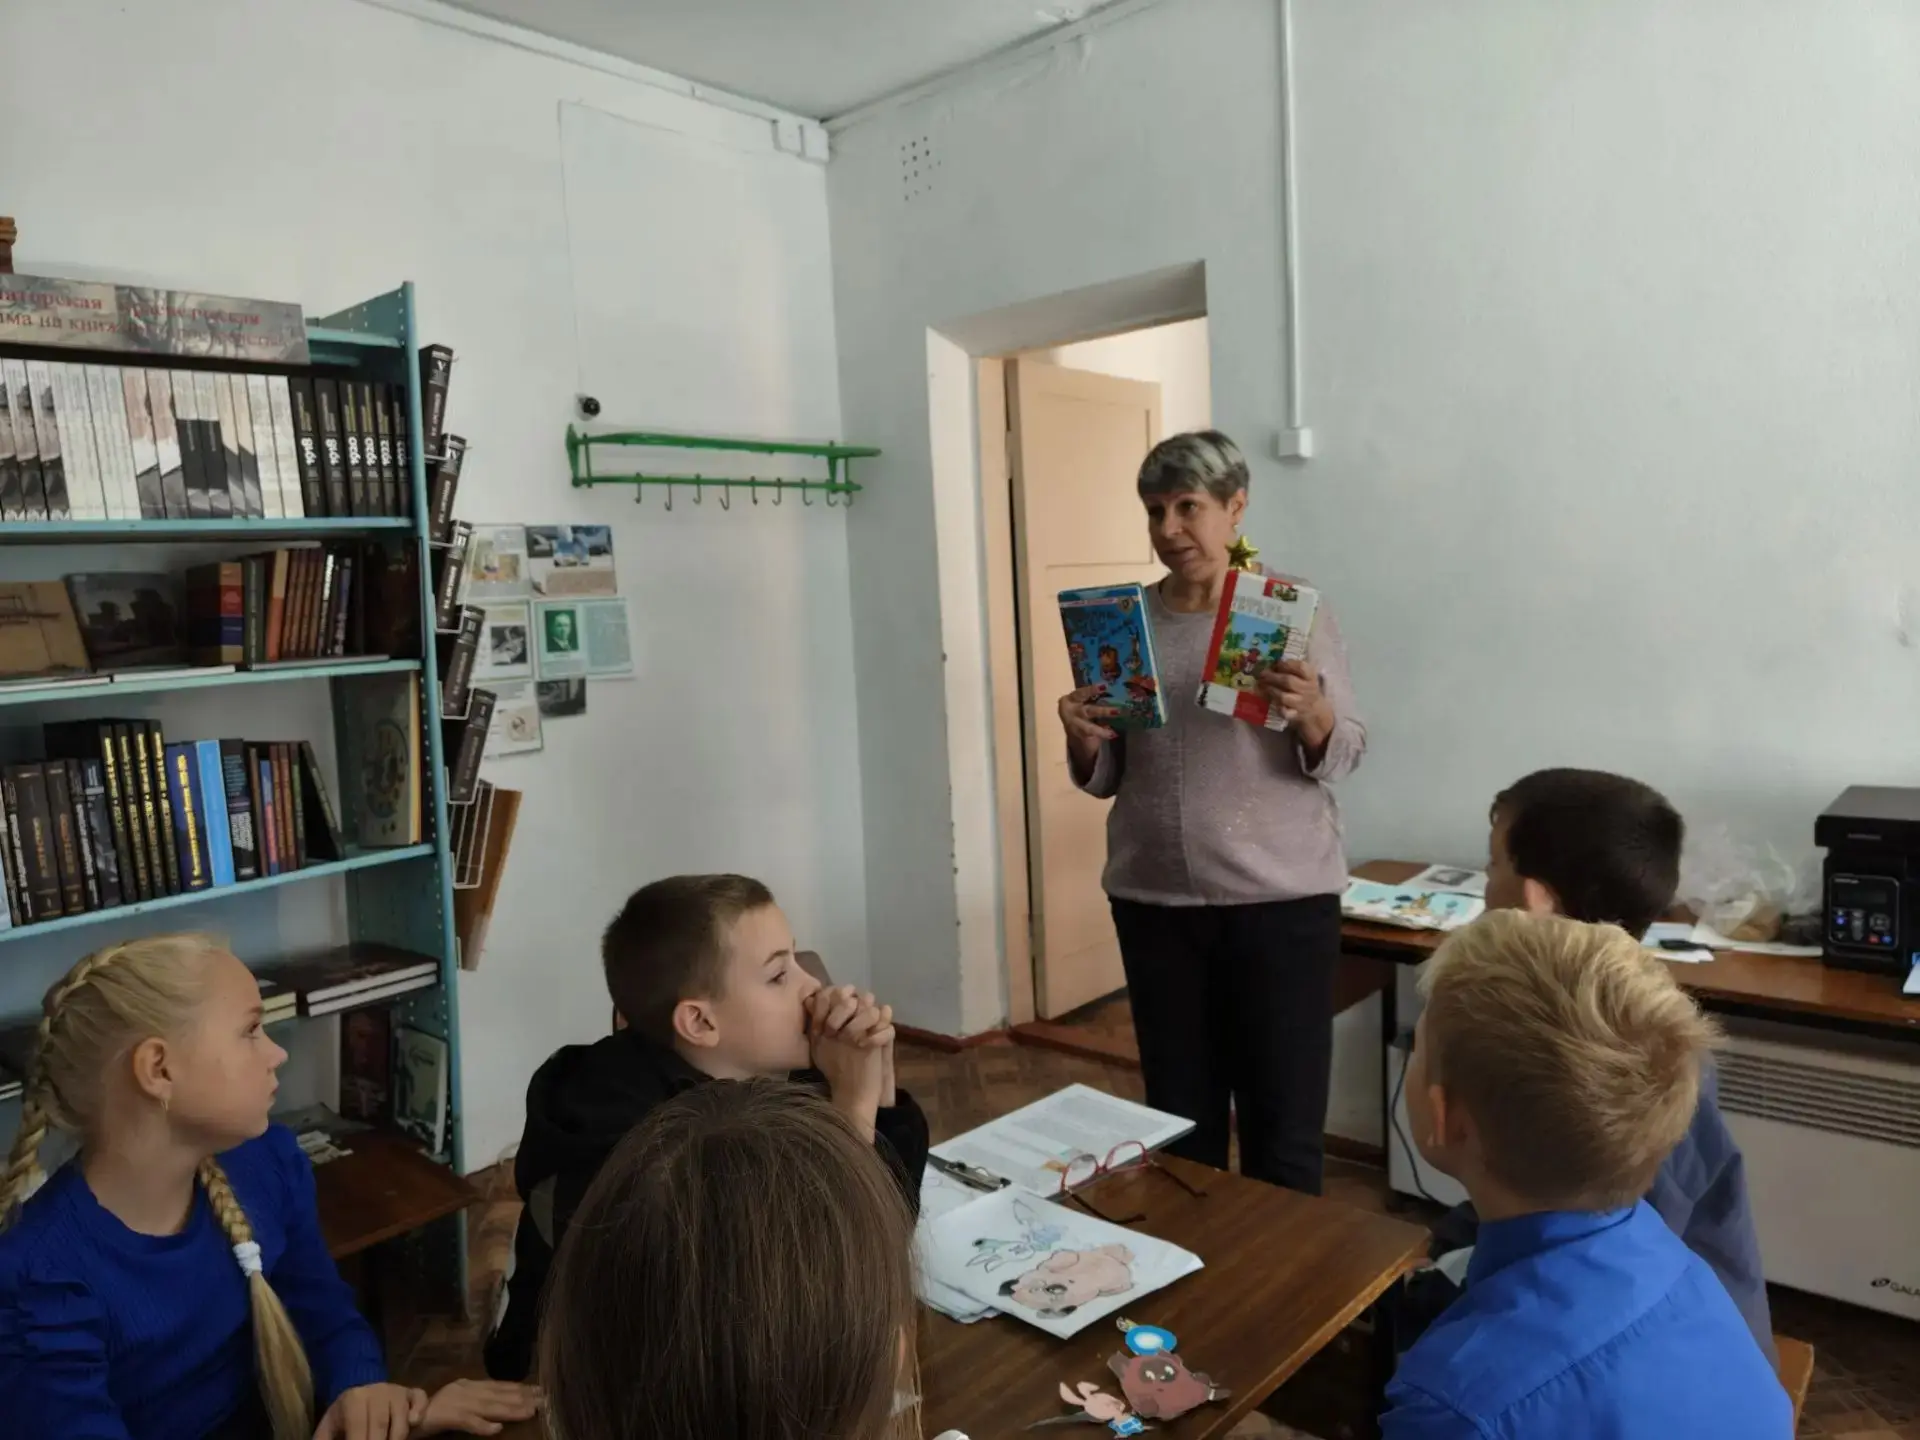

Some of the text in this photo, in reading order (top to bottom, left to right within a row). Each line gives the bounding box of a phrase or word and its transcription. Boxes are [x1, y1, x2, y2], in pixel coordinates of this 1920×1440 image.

[300, 437, 317, 466] 1918
[324, 437, 341, 466] 1918
[347, 436, 362, 466] 1920
[363, 436, 378, 467] 1920
